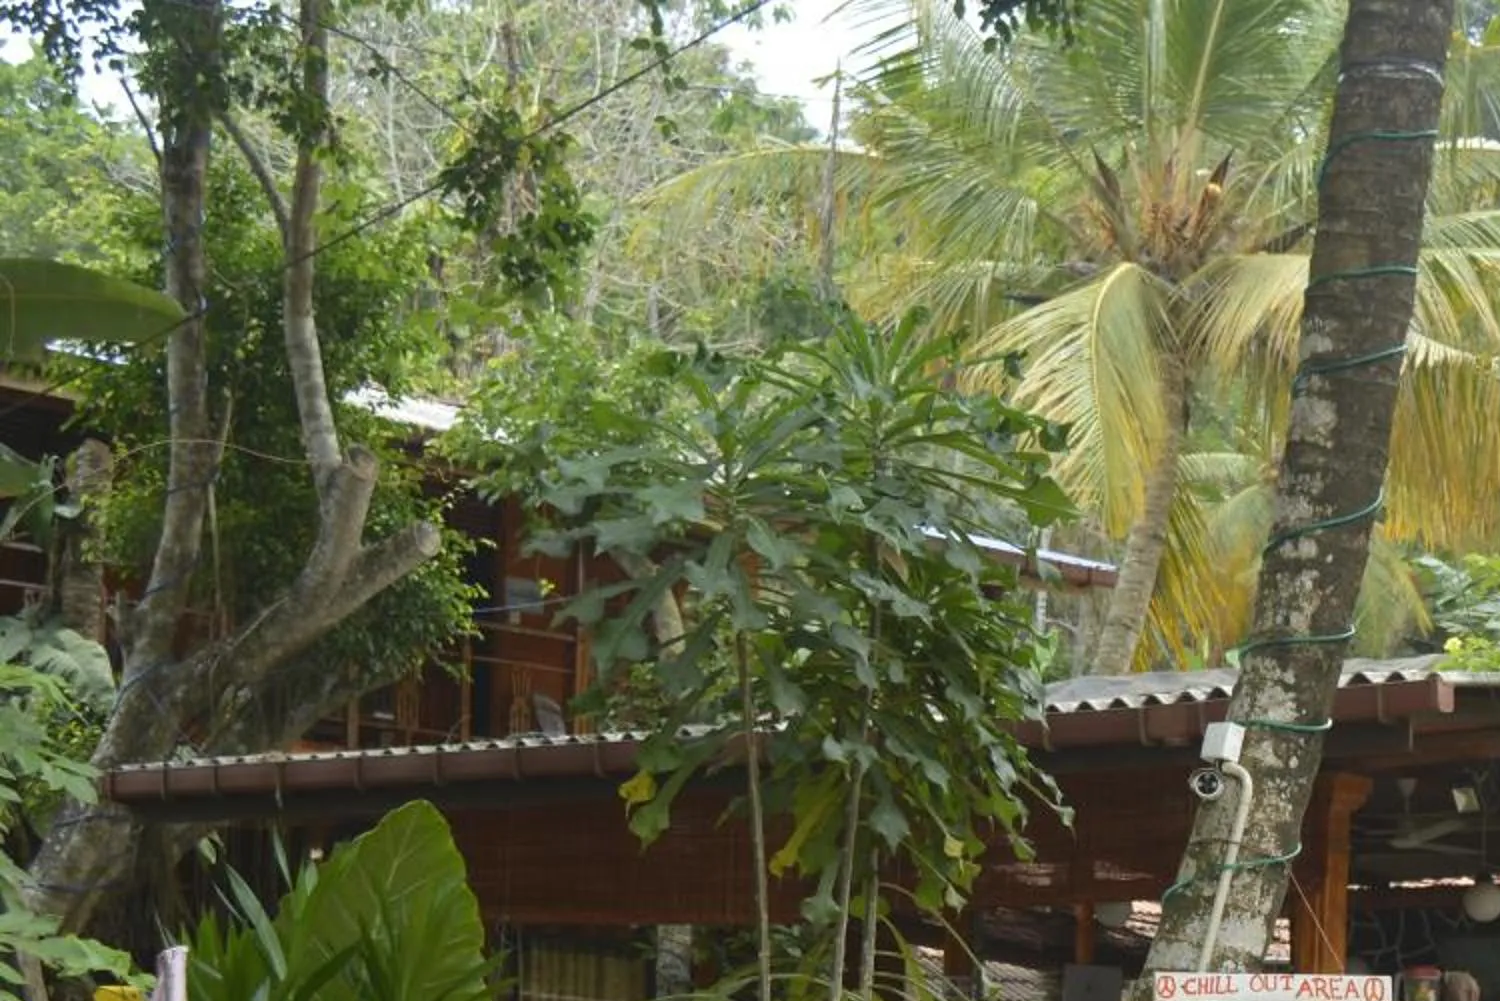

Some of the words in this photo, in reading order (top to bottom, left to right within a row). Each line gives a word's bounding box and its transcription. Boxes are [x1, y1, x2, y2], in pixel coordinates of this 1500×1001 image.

[1183, 975, 1238, 995] CHILL
[1249, 974, 1293, 993] OUT
[1296, 977, 1360, 1000] AREA
